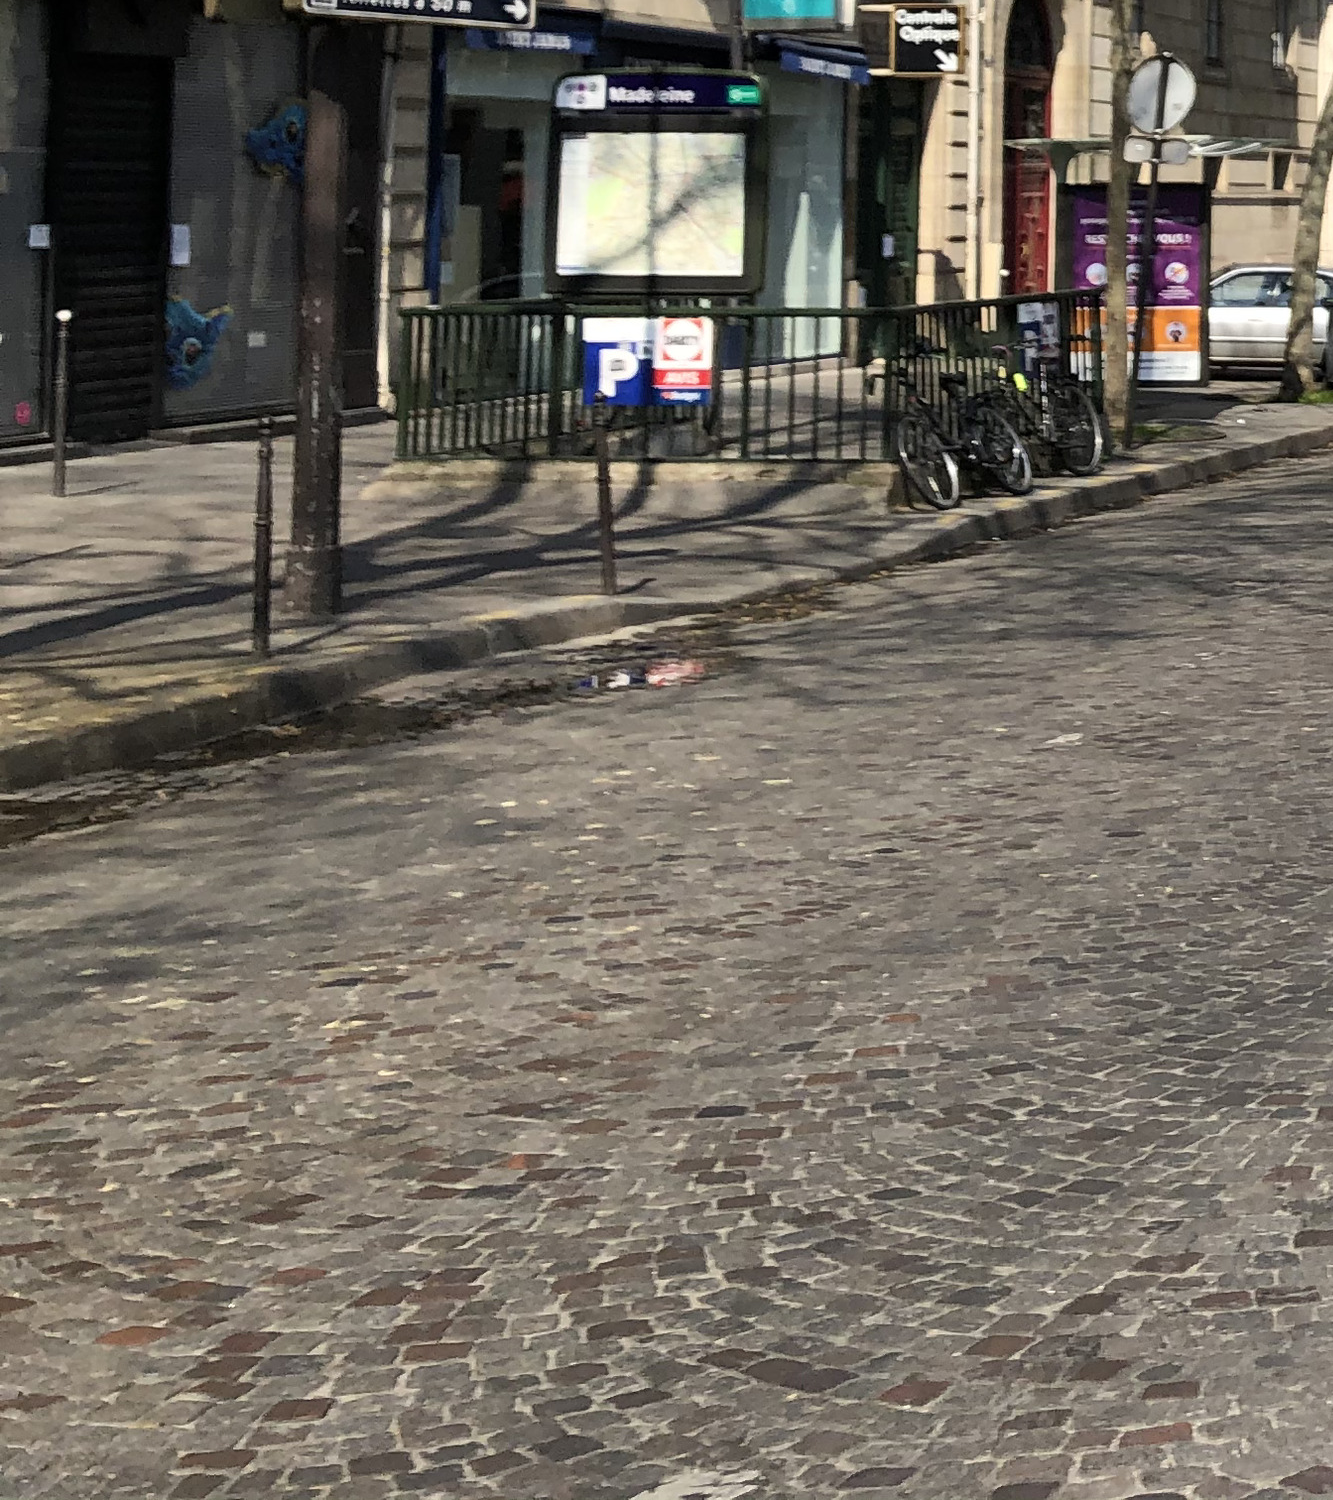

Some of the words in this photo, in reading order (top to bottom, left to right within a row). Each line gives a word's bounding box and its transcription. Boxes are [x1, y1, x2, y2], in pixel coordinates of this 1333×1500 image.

[456, 0, 472, 13] m
[608, 86, 696, 103] Madeleine
[598, 348, 640, 398] P
